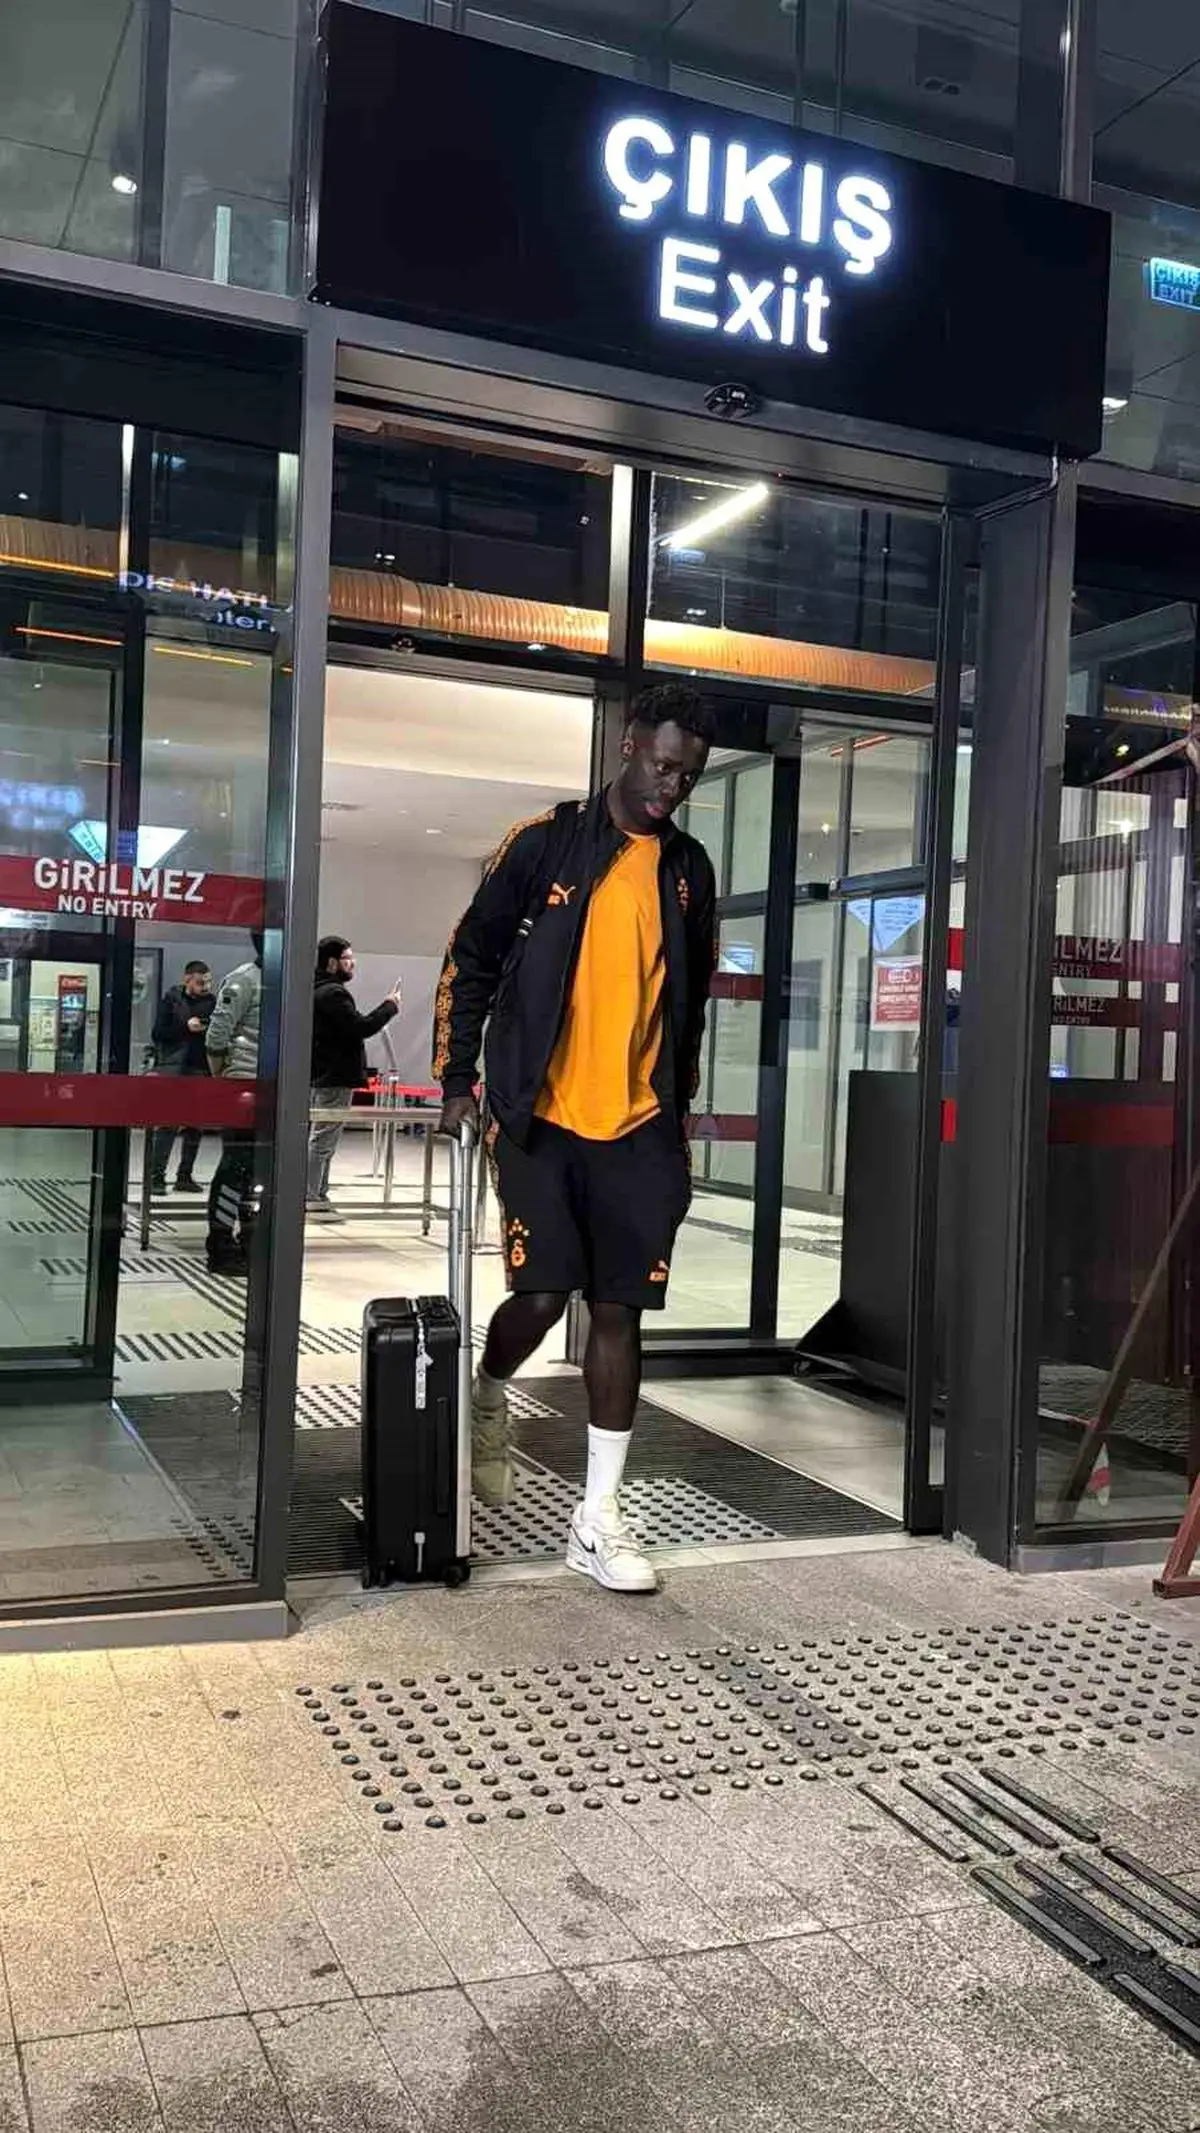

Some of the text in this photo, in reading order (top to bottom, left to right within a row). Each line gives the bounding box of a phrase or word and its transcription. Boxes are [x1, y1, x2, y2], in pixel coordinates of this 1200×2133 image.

[604, 117, 893, 275] ÇIKIŞ
[659, 237, 831, 354] Exit
[58, 895, 158, 919] NO ENTRY
